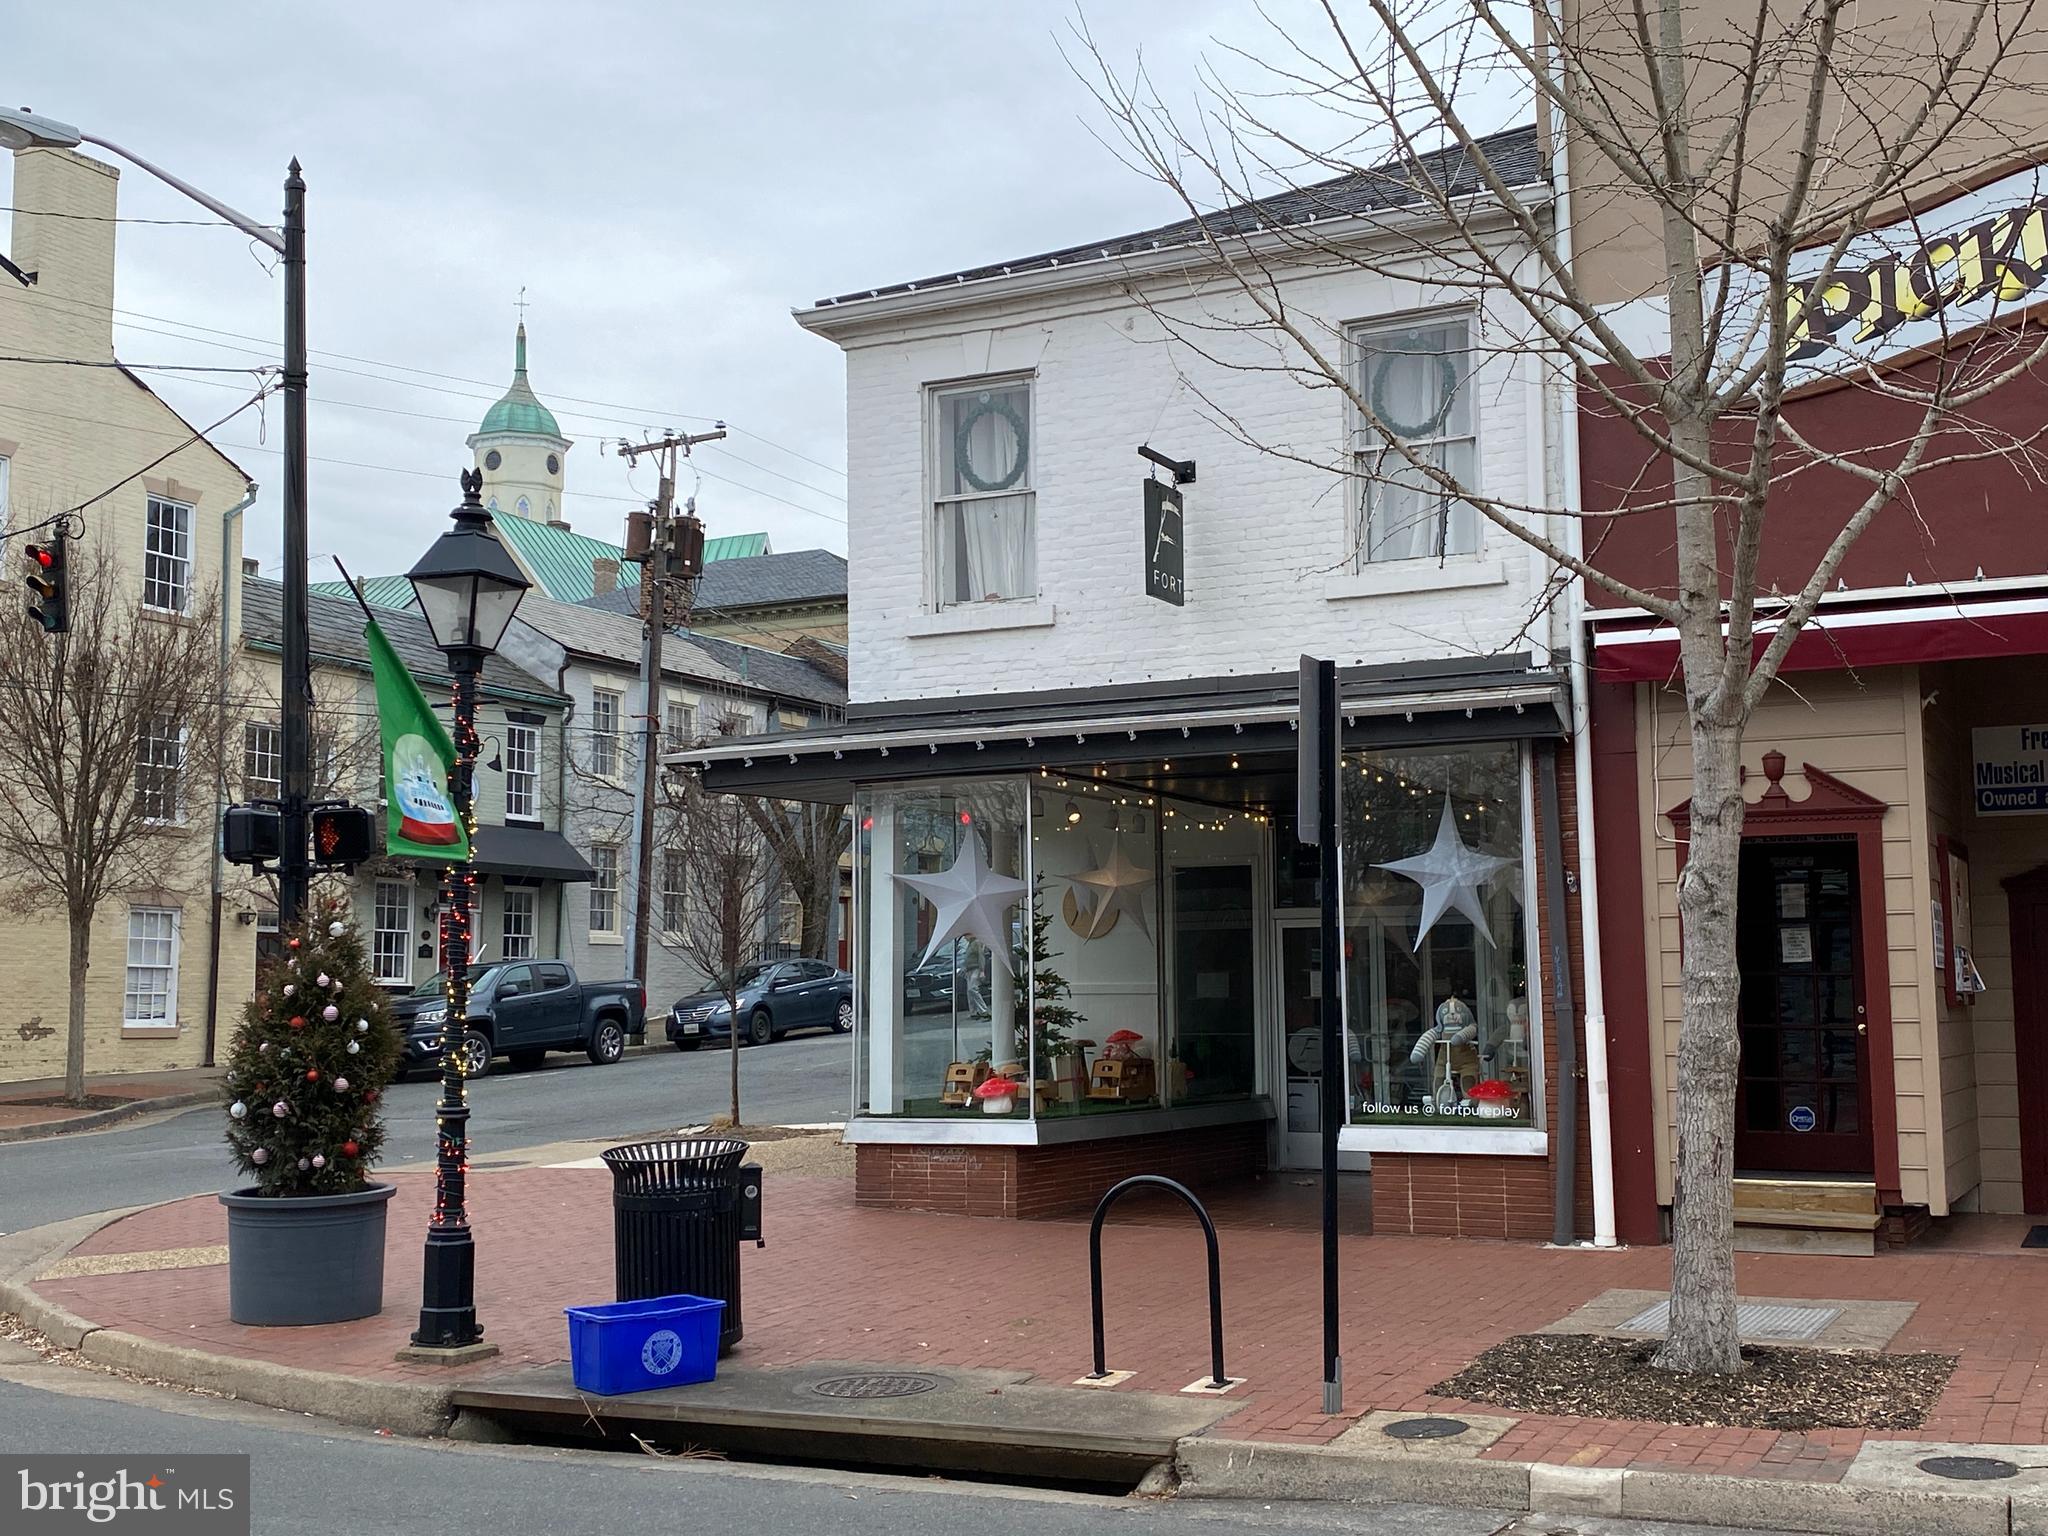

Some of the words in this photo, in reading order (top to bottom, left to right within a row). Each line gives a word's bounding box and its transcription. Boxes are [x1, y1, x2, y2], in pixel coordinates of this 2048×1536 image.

[1785, 196, 2048, 361] PICK
[1153, 569, 1183, 594] FORT
[1976, 759, 2045, 785] Musical
[1982, 788, 2038, 807] Owned
[1362, 1101, 1401, 1114] follow
[1404, 1104, 1419, 1114] us
[1422, 1104, 1436, 1117] @
[1439, 1102, 1521, 1119] fortpureplay
